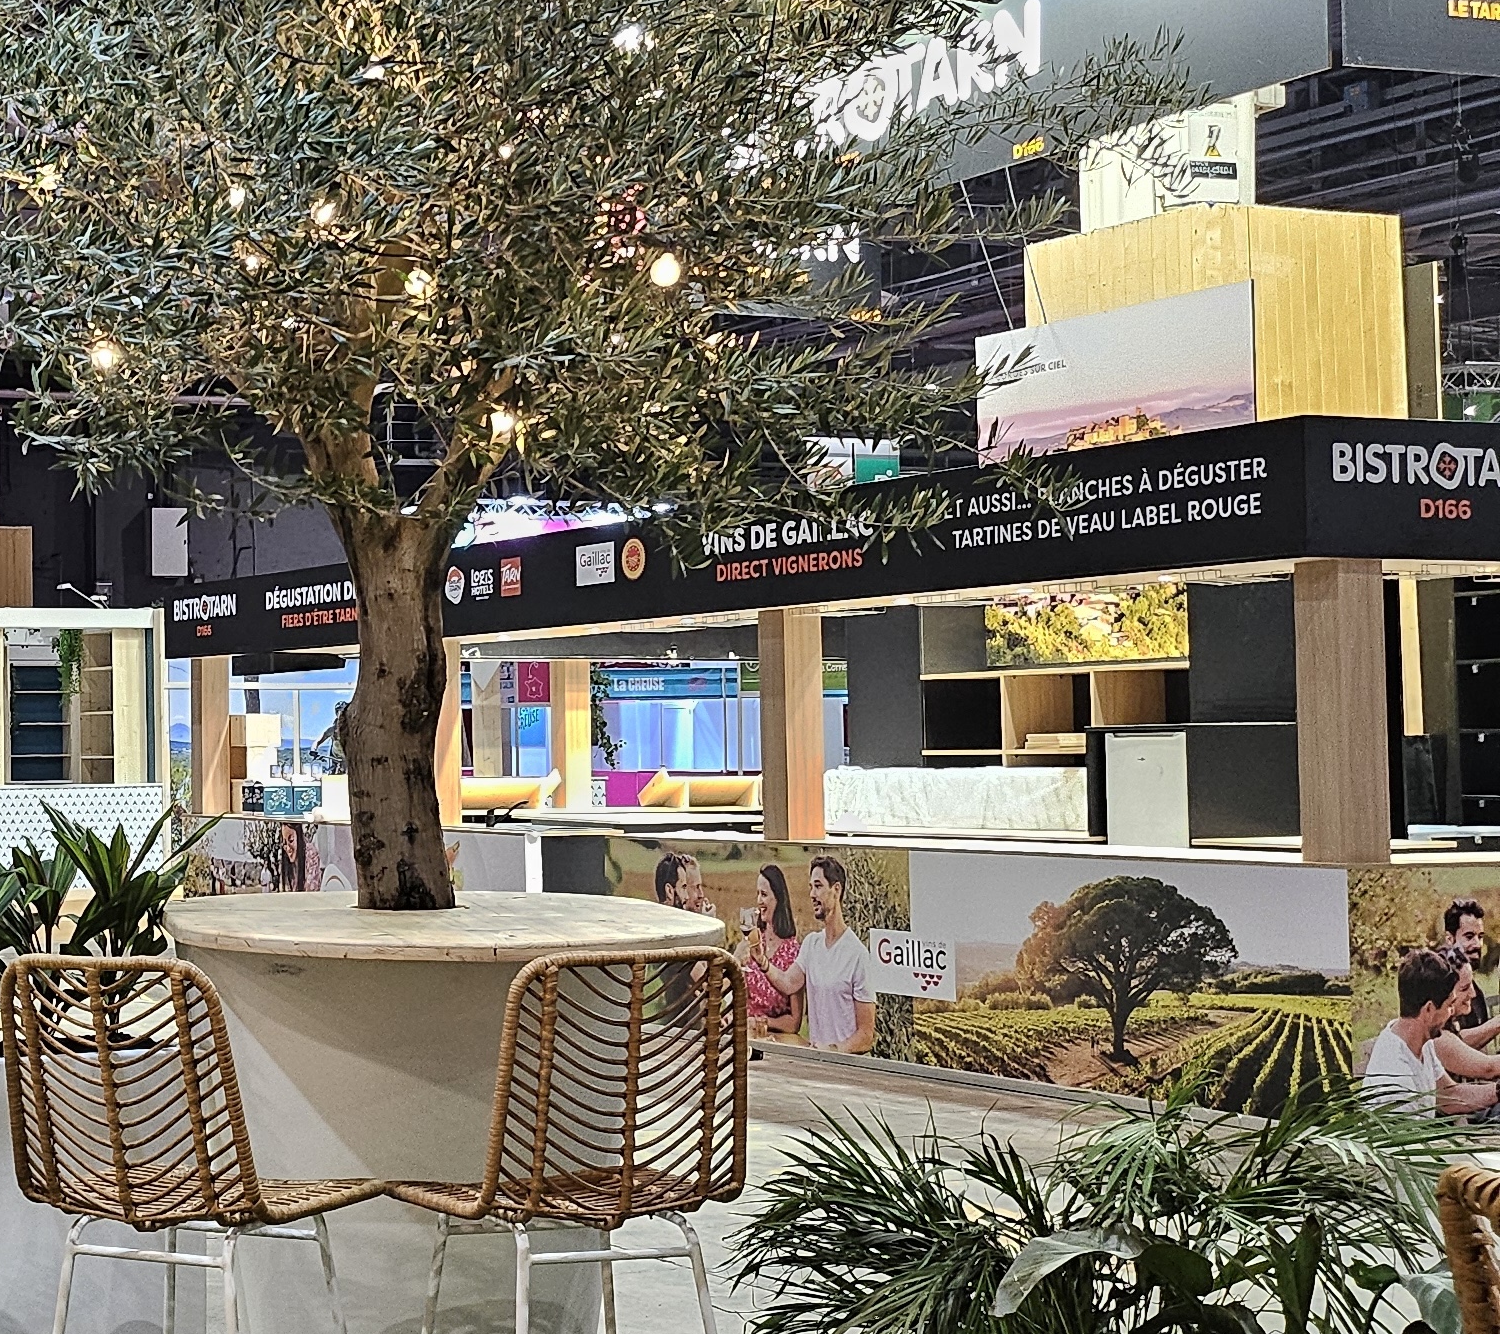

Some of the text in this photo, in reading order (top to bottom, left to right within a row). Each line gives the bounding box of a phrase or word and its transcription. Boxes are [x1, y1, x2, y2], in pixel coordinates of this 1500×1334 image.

[1048, 359, 1067, 371] CIEL
[1138, 467, 1153, 494] À
[1158, 457, 1268, 491] DÉGUSTER
[952, 492, 1262, 549] TARTINES DE VEAU LABEL ROUGE
[1420, 498, 1472, 520] D166
[702, 527, 746, 556] VINS
[750, 522, 778, 550] DE
[580, 551, 611, 567] Gaillac
[716, 547, 864, 582] DIRECT VIGNERONS
[173, 593, 237, 622] BISTROTARN
[265, 582, 341, 610] DÉGUSTATION
[281, 613, 304, 628] FIERS
[613, 677, 665, 692] La CREUSE
[877, 938, 947, 971] Gaillac
